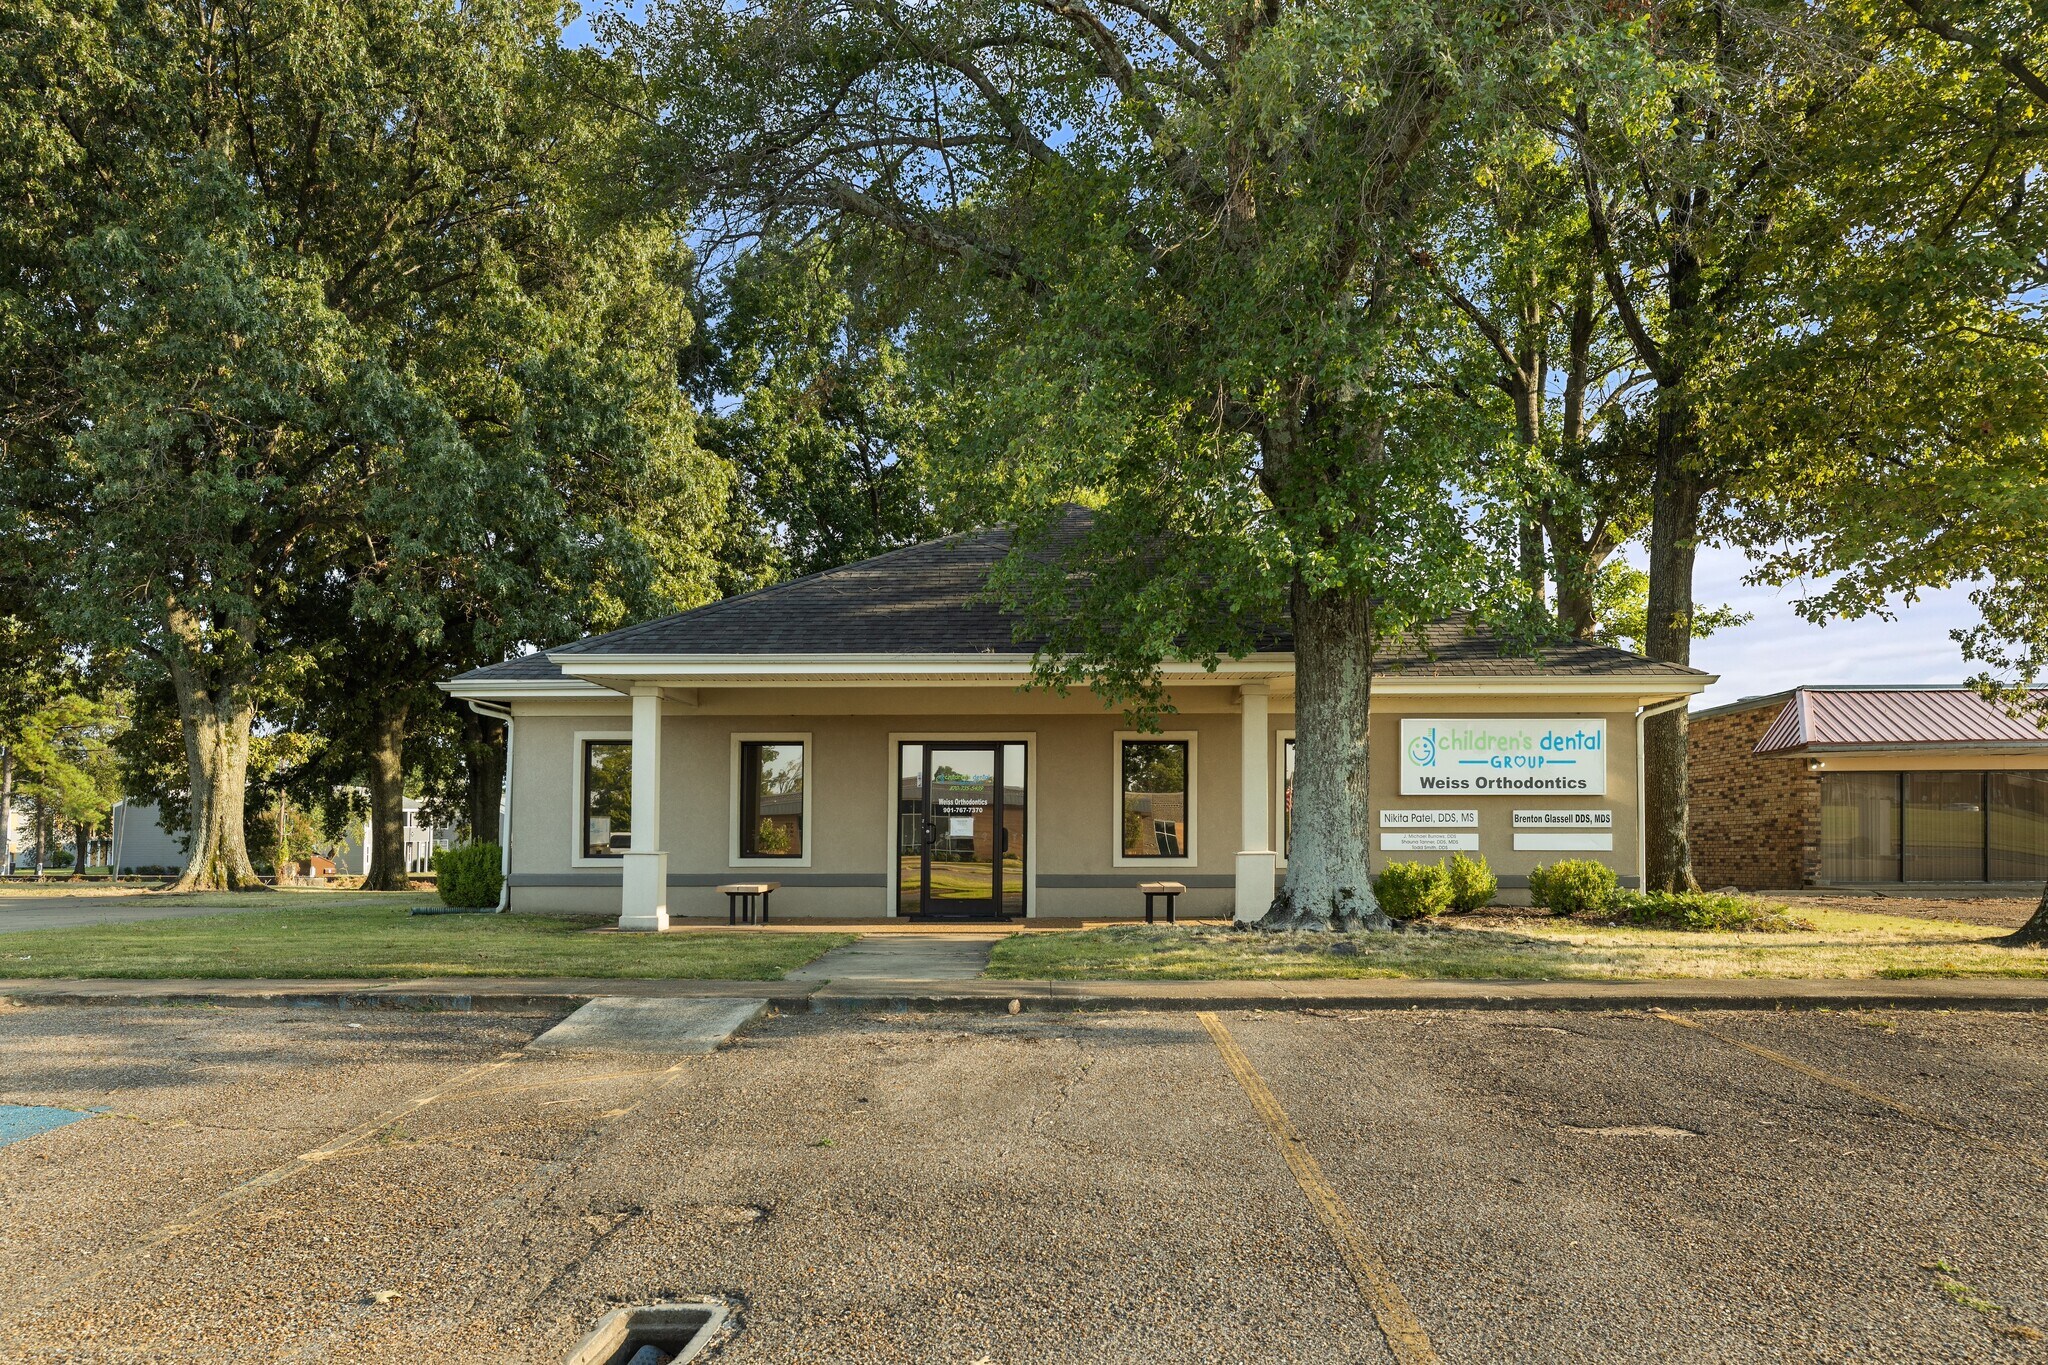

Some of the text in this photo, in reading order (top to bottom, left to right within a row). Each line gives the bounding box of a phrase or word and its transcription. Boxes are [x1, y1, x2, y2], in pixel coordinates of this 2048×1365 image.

[1438, 728, 1601, 751] children's dental
[1420, 776, 1588, 789] Weiss Orthodontics
[1384, 813, 1475, 823] Nikita Patel, DDS, MS
[1514, 814, 1611, 825] Brenton Glassell DDS, MDS
